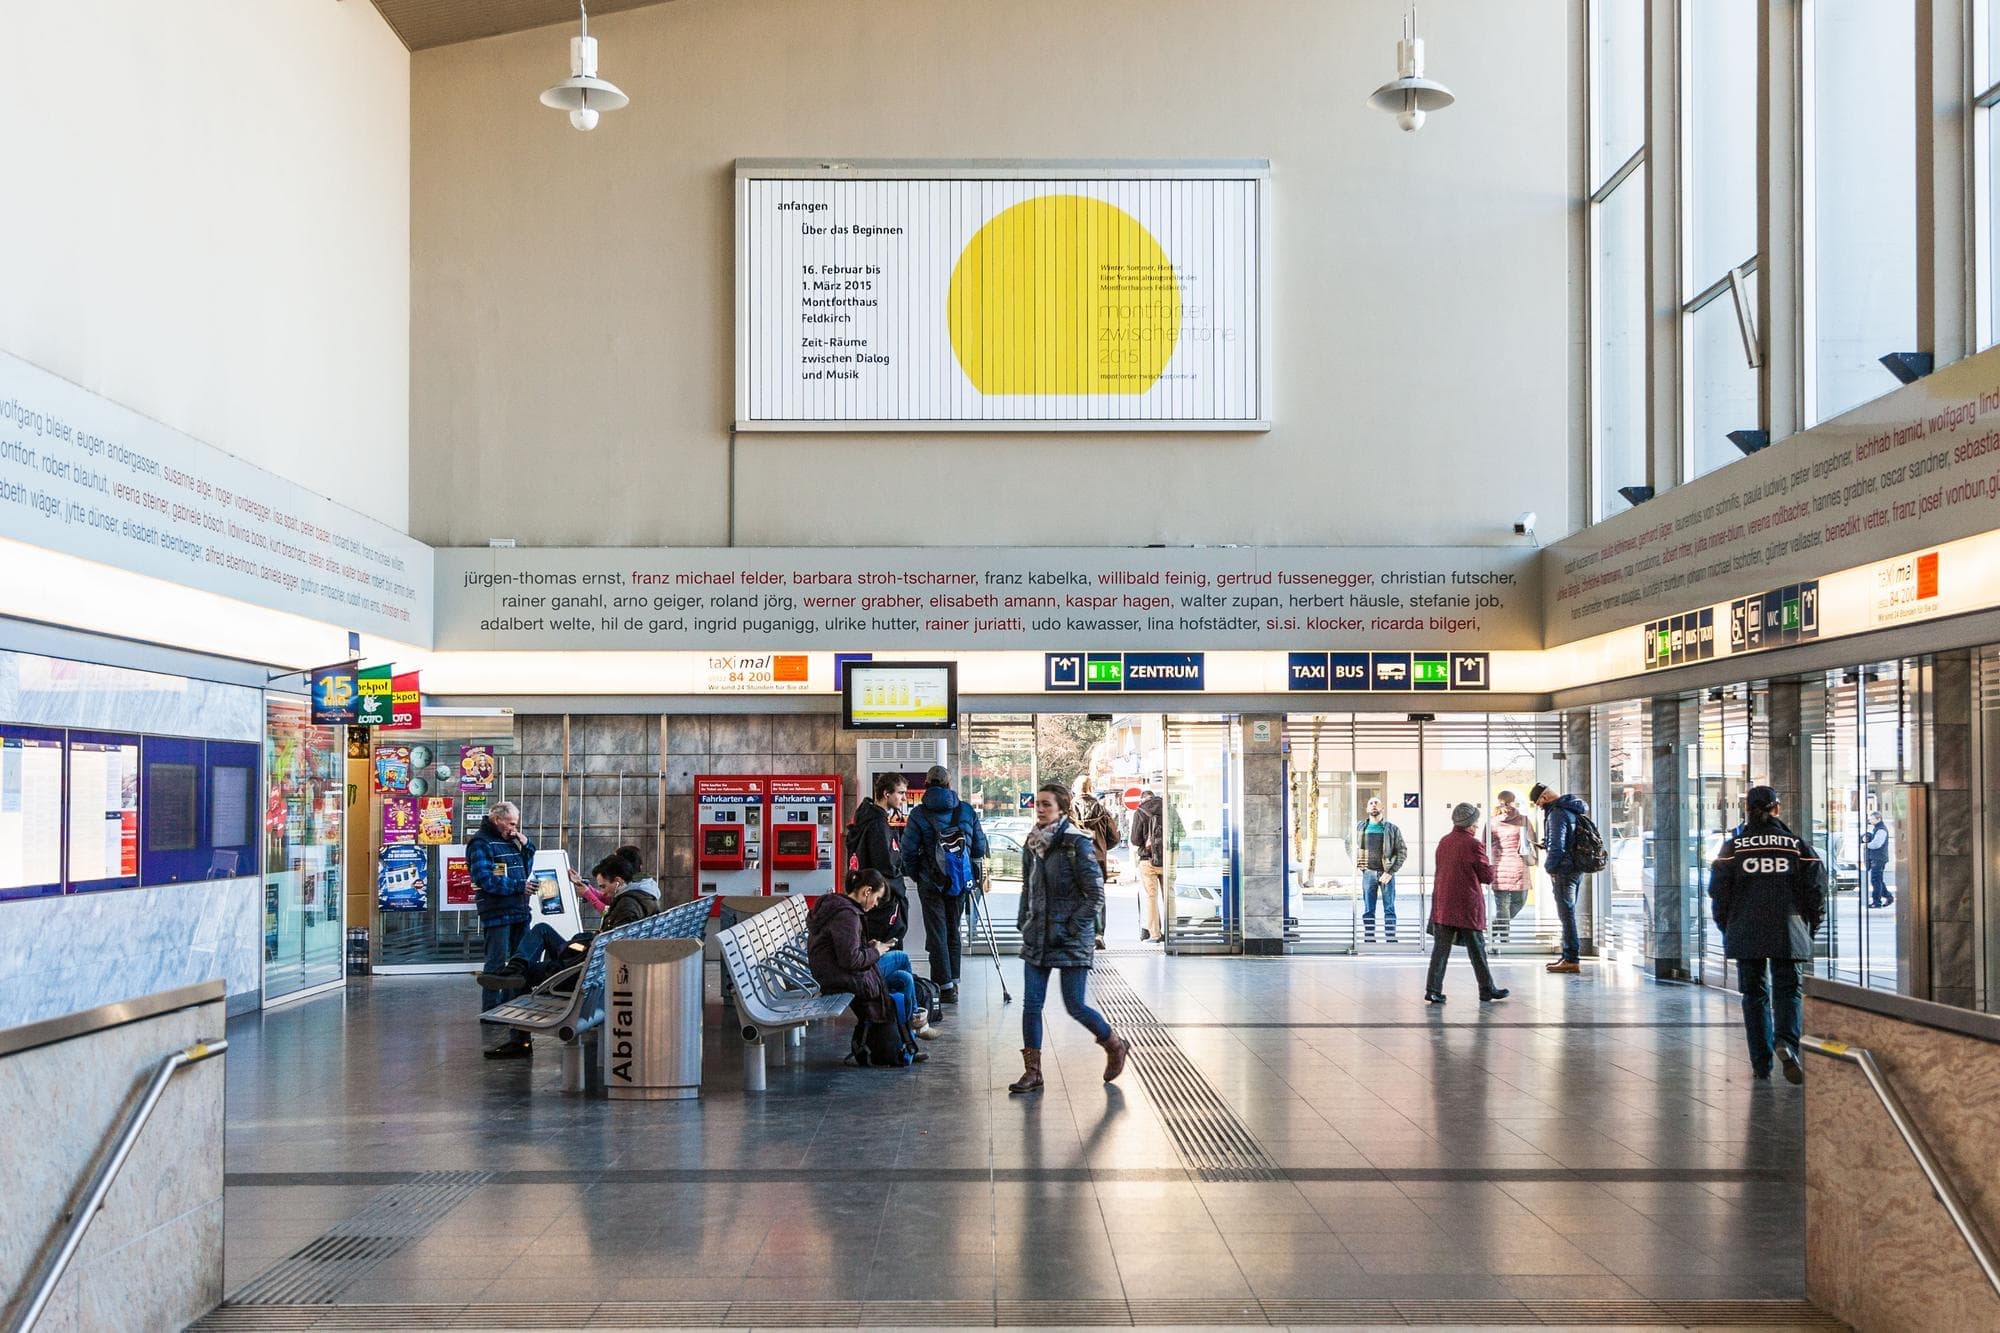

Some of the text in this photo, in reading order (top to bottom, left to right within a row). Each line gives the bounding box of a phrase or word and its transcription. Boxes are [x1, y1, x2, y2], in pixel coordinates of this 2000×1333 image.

[777, 200, 829, 214] anfangen
[801, 222, 904, 238] Über das Beginnen
[802, 264, 881, 275] 16. Februar bis
[802, 280, 873, 291] 1. März 2015
[801, 296, 878, 307] Montforthaus
[1099, 299, 1208, 319] montforter
[801, 313, 851, 323] Feldkirch
[1099, 323, 1238, 342] zwischentöne
[801, 336, 868, 348] Zeit-Räume
[801, 353, 890, 366] zwischen Dialog
[1099, 348, 1140, 364] 2015
[801, 369, 860, 380] und Musik
[46, 412, 73, 447] bleier,
[77, 430, 104, 457] eugen
[107, 442, 161, 480] andergassen,
[164, 466, 194, 491] susanne
[1791, 466, 1809, 492] peter
[1855, 431, 1889, 463] lechhab
[1893, 417, 1925, 448] hamid,
[1928, 401, 1975, 435] wolfgang
[73, 462, 109, 497] blauhut,
[1812, 490, 1840, 513] hannes
[1843, 476, 1877, 506] grabher,
[1880, 467, 1905, 489] oscar
[1909, 451, 1950, 480] sandner,
[112, 481, 139, 504] verena
[142, 489, 169, 517] steiner,
[173, 502, 200, 526] gabriele
[31, 488, 61, 519] wäger,
[65, 497, 84, 525] jytte
[88, 505, 119, 536] dünser,
[123, 517, 158, 545] elisabeth
[205, 544, 223, 565] alfred
[1766, 539, 1787, 564] günter
[1825, 514, 1859, 542] benedikt
[1863, 507, 1889, 531] vetter,
[1892, 501, 1915, 522] franz
[1918, 487, 1942, 519] josef
[371, 573, 384, 589] robert
[464, 571, 1516, 588] jürgen-thomas ernst, franz michael felder, barbara stroh-tscharner, franz kabelka, willibald feinig, gertrud fussenegger, christian futscher,
[503, 593, 1503, 610] rainer ganahl, arno geiger, roland jörg, werner grabher, elisabeth amann, kaspar hagen, walter zupan, herbert häusle, stefanie job,
[480, 617, 1480, 633] adalbert welte, hil de gard, ingrid puganigg, ulrike hutter, rainer juriatti, udo kawasser, lina hofstädter, si.si. klocker, ricarda bilgeri,
[1767, 610, 1779, 627] WC
[1699, 626, 1713, 642] TAXI
[739, 655, 772, 669] mal
[729, 672, 745, 682] 84
[748, 672, 771, 682] 200
[1129, 665, 1199, 678] ZENTRUM
[1292, 665, 1325, 678] TAXI
[1335, 665, 1364, 678] BUS
[319, 675, 353, 707] 15
[702, 794, 744, 803] Fahrkarten
[774, 794, 816, 803] Fahrkarten
[1734, 834, 1801, 849] SECURITY
[1742, 857, 1790, 873] ÖBB
[612, 991, 633, 1083] Abfall
